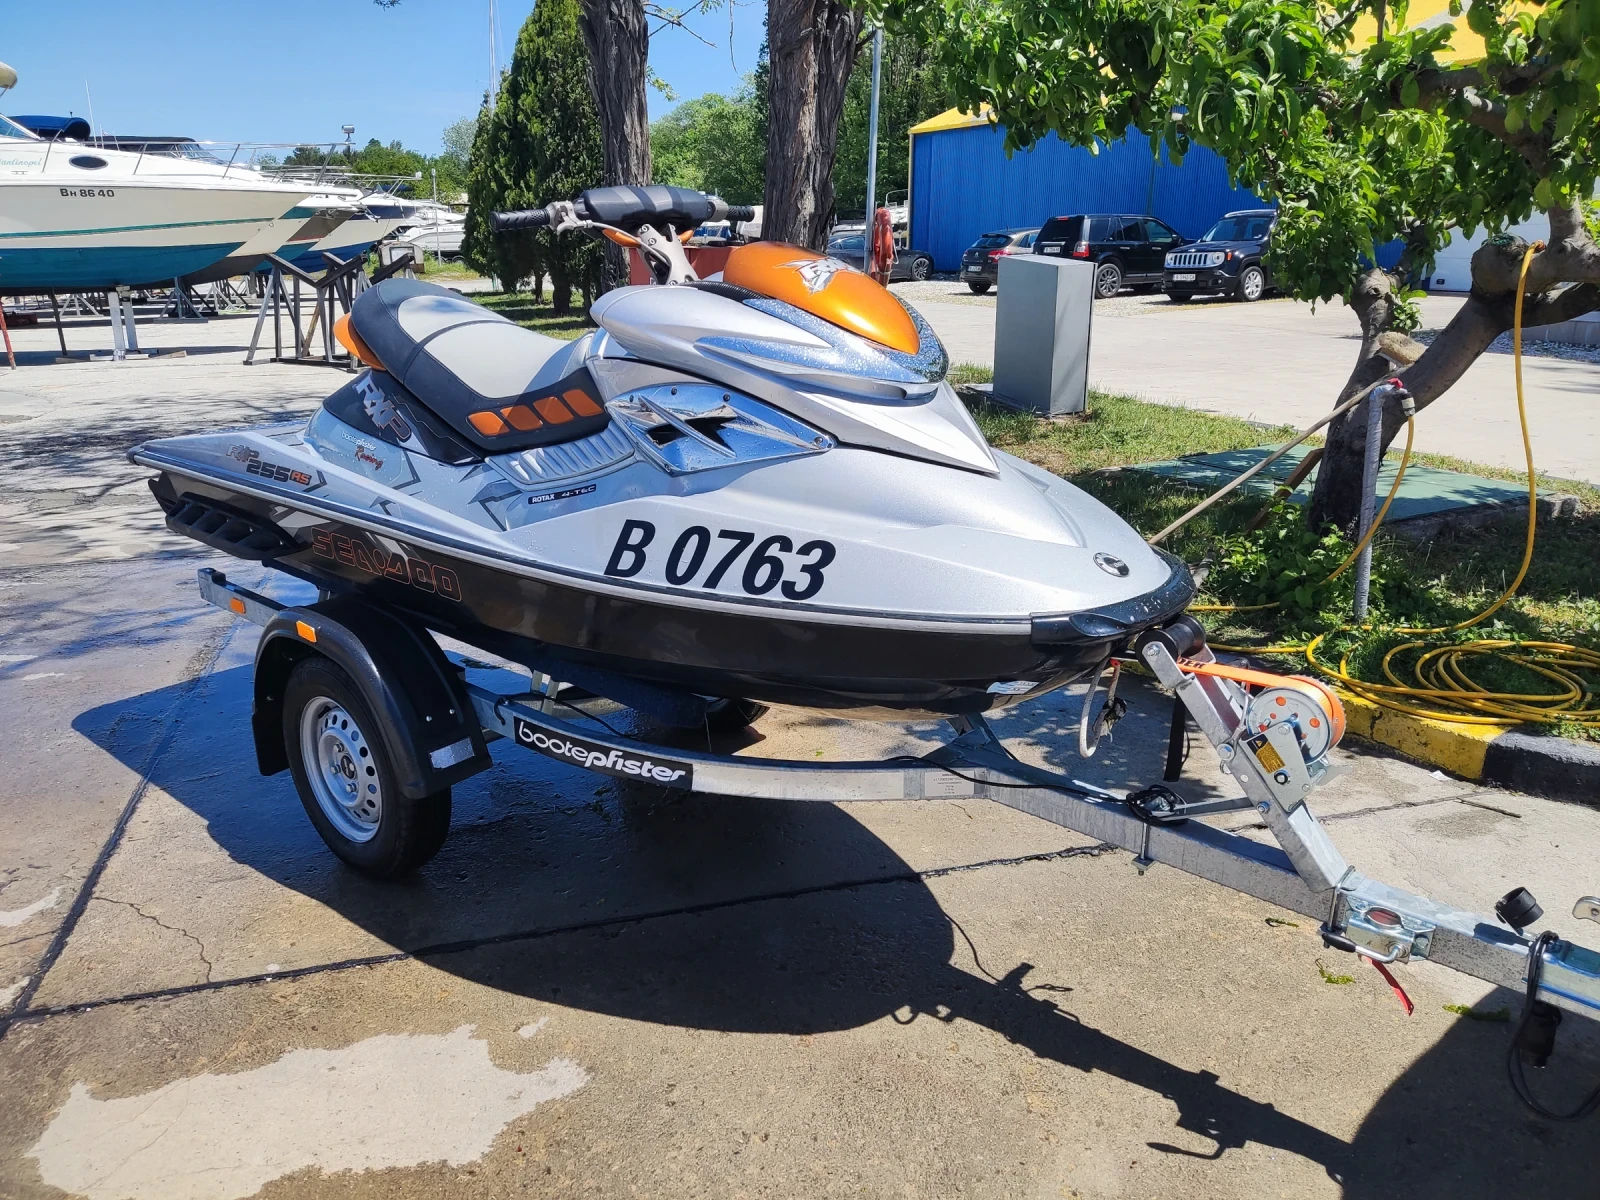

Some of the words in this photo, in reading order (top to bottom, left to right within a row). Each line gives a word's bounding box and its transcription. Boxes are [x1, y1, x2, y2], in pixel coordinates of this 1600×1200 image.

[532, 494, 555, 503] ROTAX
[603, 519, 656, 577] B
[665, 525, 836, 601] 0763
[519, 721, 686, 782] bootepfister
